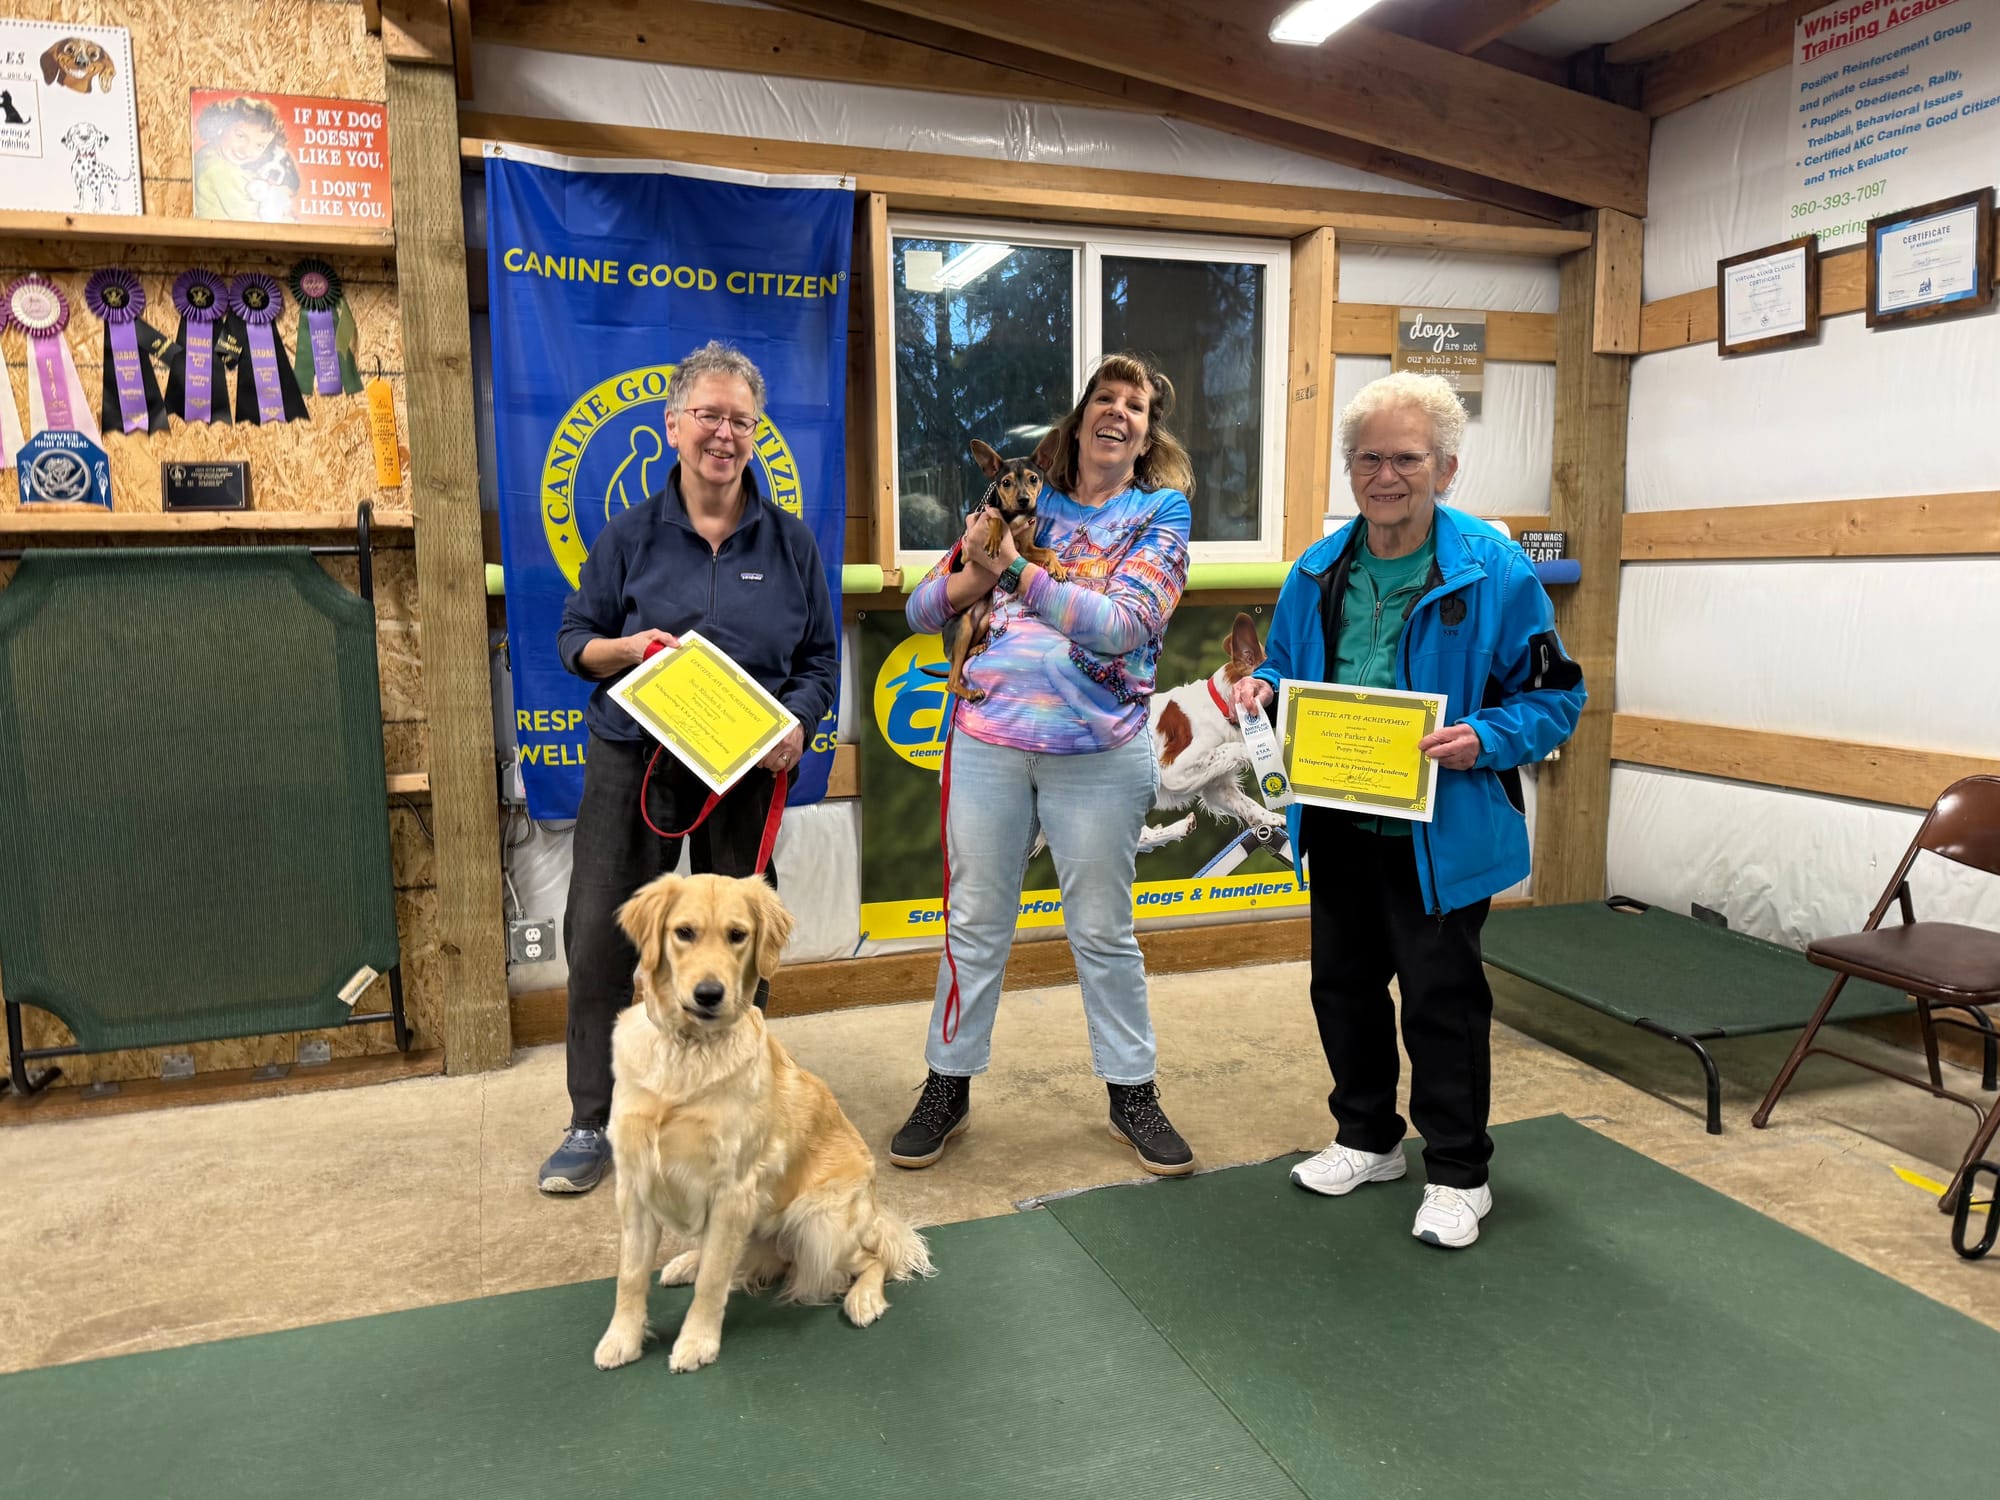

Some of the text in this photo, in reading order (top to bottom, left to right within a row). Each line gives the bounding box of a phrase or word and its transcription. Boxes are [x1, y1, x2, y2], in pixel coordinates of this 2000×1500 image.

[1801, 19, 1880, 60] Training
[1800, 21, 1973, 92] Positive Reinforcement Group
[1799, 65, 1910, 112] and private classes!
[1810, 69, 1963, 129] Puppies, Obedience, Rally,
[293, 107, 382, 129] IF MY DOG
[1856, 102, 1920, 131] Behavioral
[1924, 89, 1964, 110] Issues
[304, 128, 374, 149] DOESN'T
[1804, 143, 1851, 167] Certified
[1853, 134, 1874, 151] AKC
[1877, 121, 1922, 141] Canine
[1926, 108, 1958, 128] Good
[298, 147, 384, 172] LIKE YOU,
[1803, 147, 1909, 186] and Trick Evaluator
[310, 179, 372, 198] I DON'T
[1790, 179, 1887, 219] 360-393-7097
[300, 198, 386, 219] LIKE YOU.
[1903, 225, 1951, 245] CERTIFICATE
[503, 247, 620, 285] CANINE
[627, 263, 718, 292] GOOD
[1409, 312, 1460, 353] dogs
[1445, 341, 1478, 351] are not
[1406, 355, 1477, 365] our whole lives
[1440, 367, 1461, 380] they
[43, 432, 79, 441] NOVICE
[67, 440, 89, 448] TRIAL
[547, 393, 612, 525] CANINE
[615, 371, 667, 403] GO
[1522, 532, 1563, 541] A DOG WAGS
[516, 709, 584, 732] RESP
[1363, 716, 1410, 727] ACHIEVEMENT
[1321, 730, 1342, 738] Arlene
[1344, 733, 1366, 741] Parker
[1375, 736, 1391, 744] Jake
[1299, 758, 1333, 767] Whispering
[1351, 765, 1377, 773] Training
[1380, 768, 1408, 777] Academy
[1136, 891, 1184, 906] dogs
[1189, 888, 1203, 901] &
[1209, 882, 1293, 899] handlers
